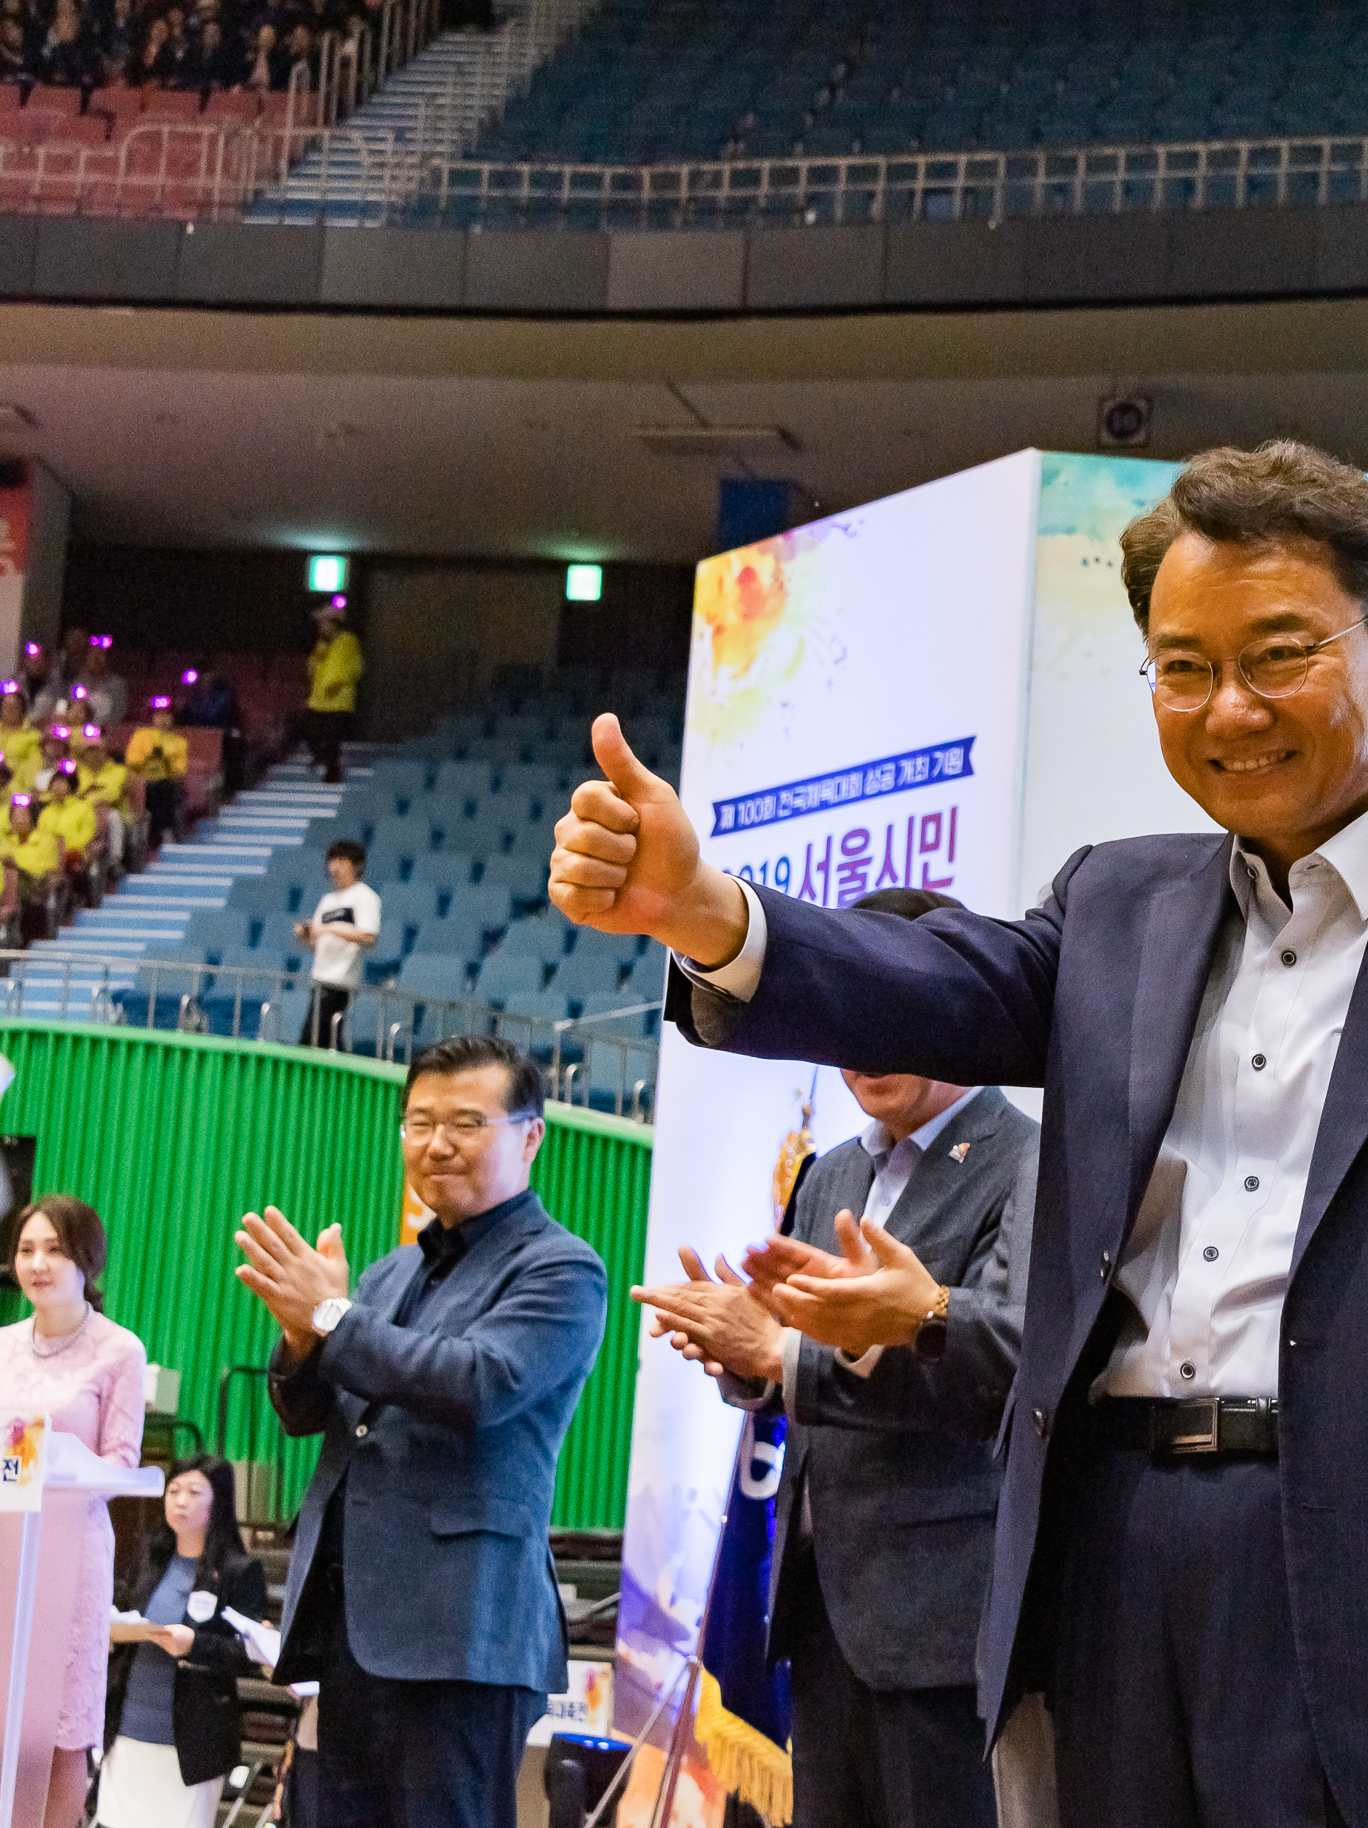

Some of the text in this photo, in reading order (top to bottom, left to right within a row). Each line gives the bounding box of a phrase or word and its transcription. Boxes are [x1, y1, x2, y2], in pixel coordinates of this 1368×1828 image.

[720, 747, 964, 831] 제 100회 전국체육대회 성공 개최 기원
[723, 806, 958, 908] 19 서울시민
[3, 1459, 19, 1482] 전
